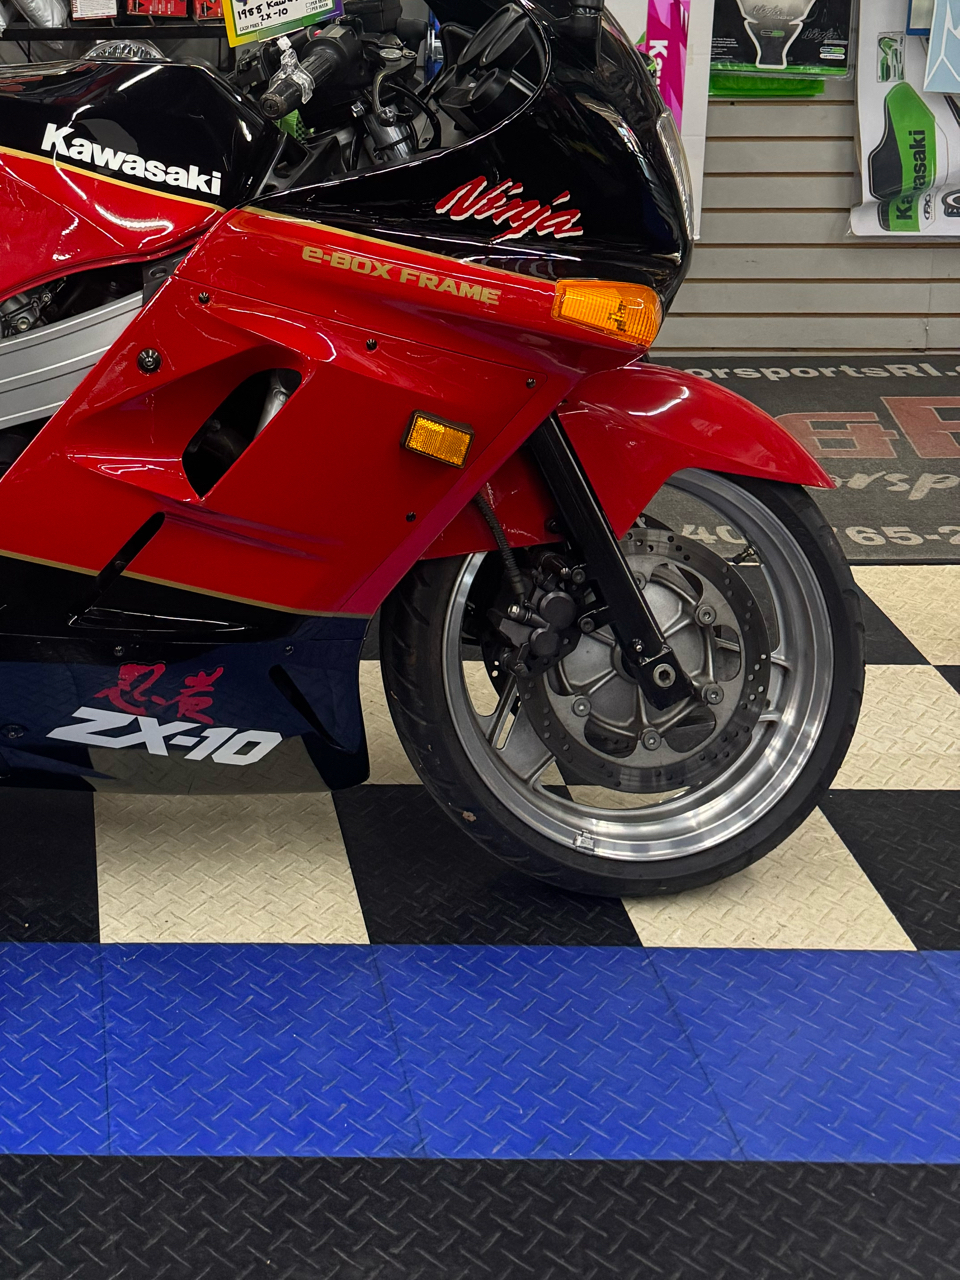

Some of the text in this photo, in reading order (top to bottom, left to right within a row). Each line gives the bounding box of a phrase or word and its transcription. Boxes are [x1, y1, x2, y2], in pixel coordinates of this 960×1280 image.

[237, 4, 264, 20] 1988
[40, 122, 222, 196] Kawasaki
[434, 175, 584, 244] Ninja
[399, 268, 502, 306] FRAME
[45, 706, 283, 766] ZX-10
